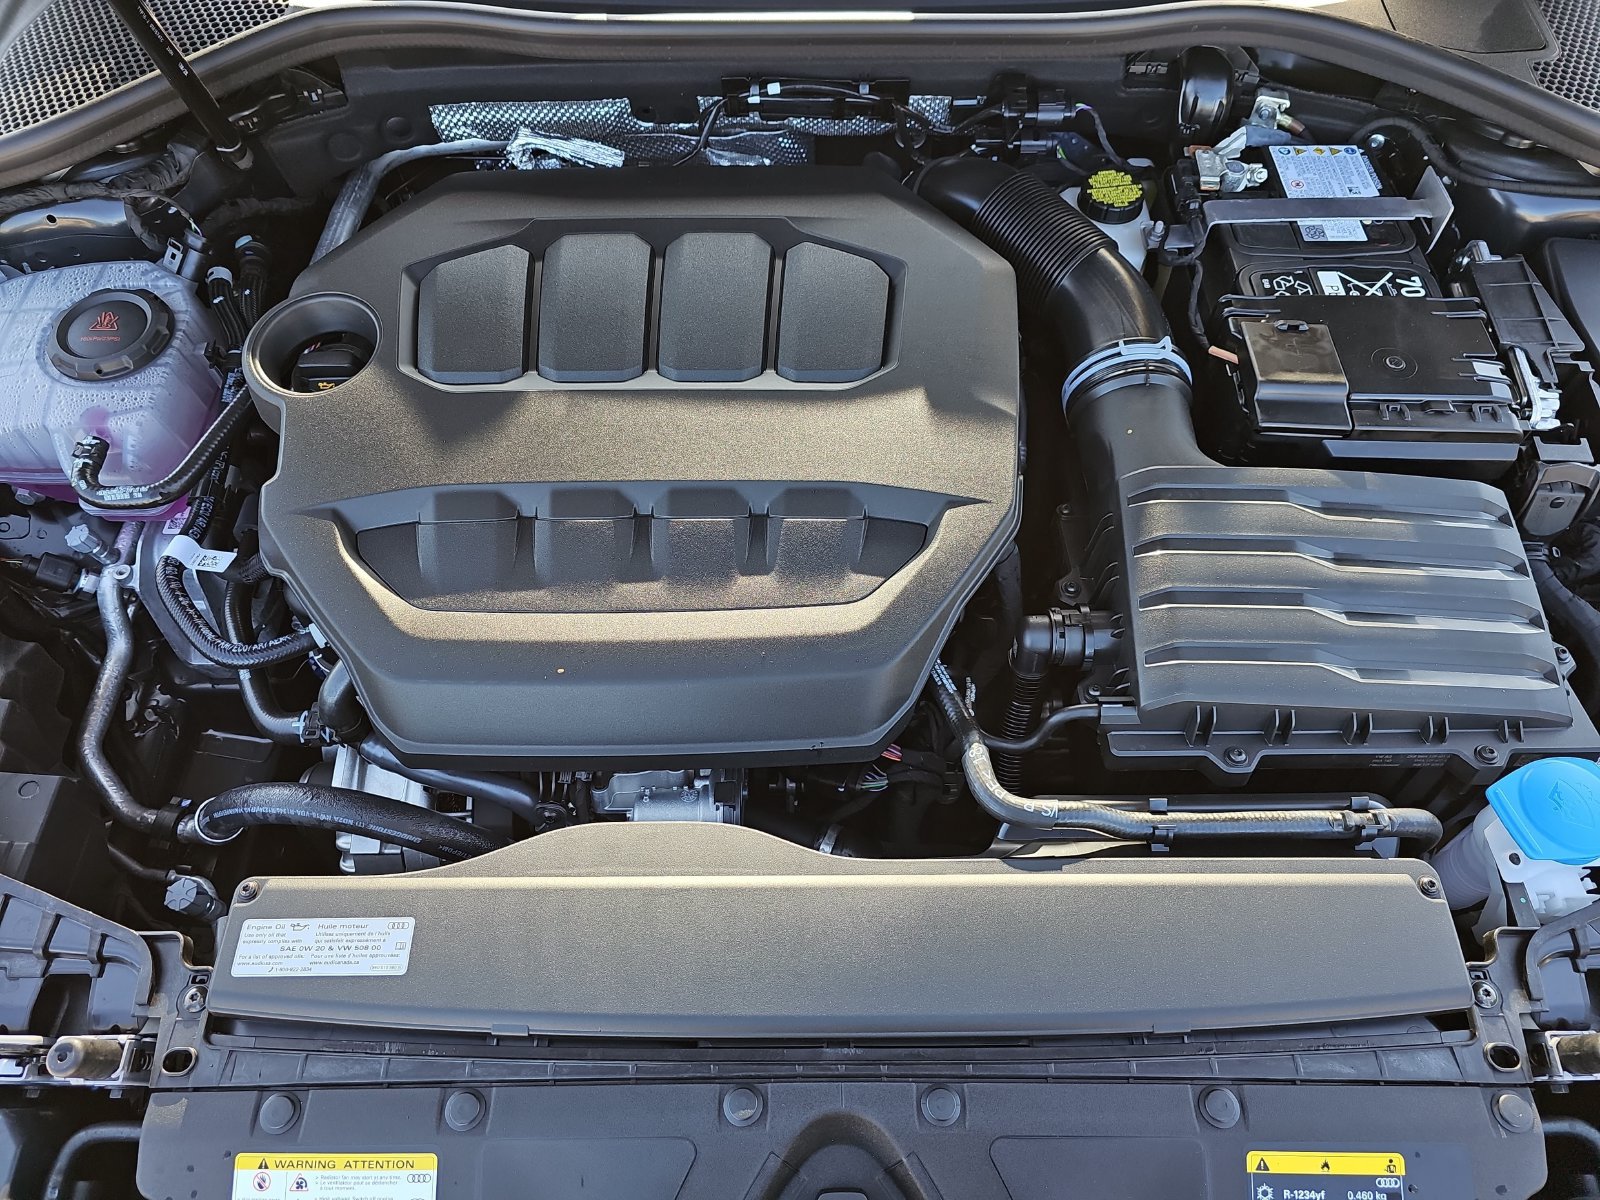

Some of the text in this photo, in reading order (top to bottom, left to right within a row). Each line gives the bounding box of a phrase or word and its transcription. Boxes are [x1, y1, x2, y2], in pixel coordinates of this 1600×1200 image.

[1396, 276, 1426, 297] 70
[274, 1160, 415, 1169] WARNING ATTENTION
[1283, 1189, 1387, 1200] R-1234yf 0.460 kg
